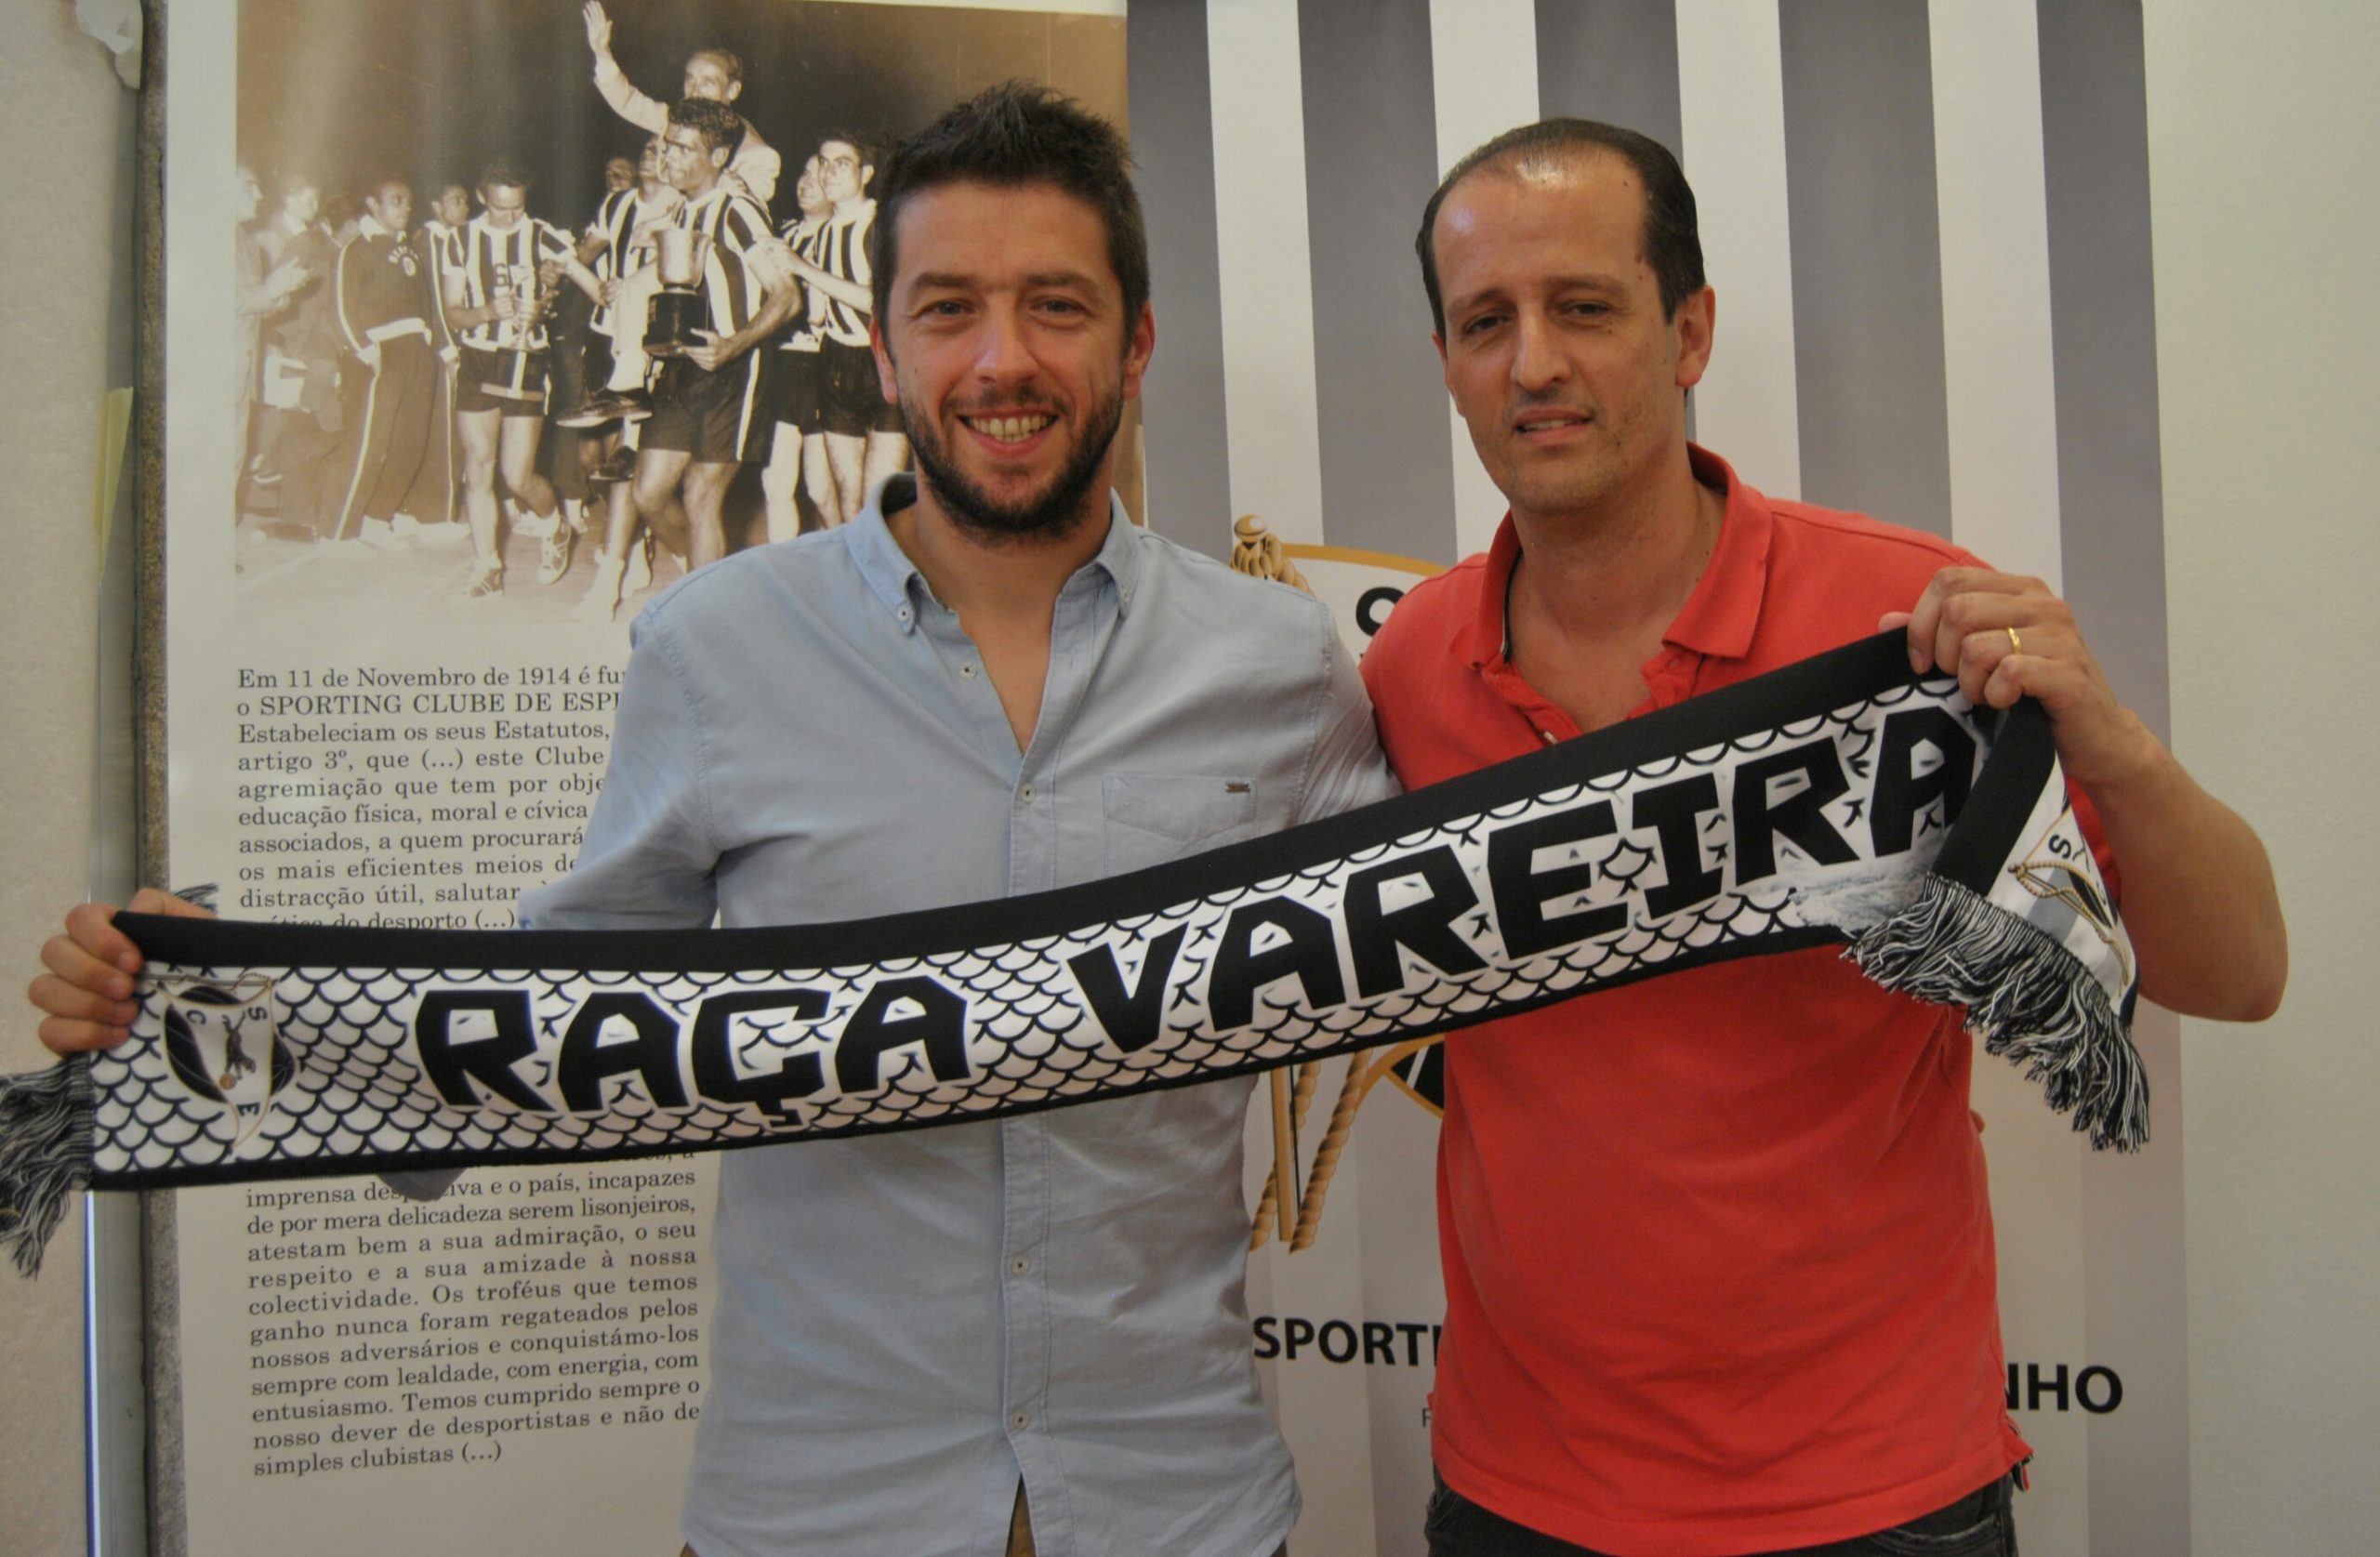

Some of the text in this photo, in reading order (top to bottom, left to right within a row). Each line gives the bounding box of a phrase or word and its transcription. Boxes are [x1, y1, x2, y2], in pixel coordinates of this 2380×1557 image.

[239, 669, 277, 688] Em
[289, 670, 311, 687] 11
[323, 668, 349, 687] de
[358, 667, 475, 686] Novembro
[483, 666, 509, 685] de
[520, 667, 570, 685] 1914
[579, 666, 589, 684] é
[237, 704, 249, 716] o
[261, 694, 401, 715] SPORTING
[414, 693, 504, 713] CLUBE
[516, 693, 551, 712] DE
[239, 720, 608, 743] Estabeleciam os seus Estatutos,
[238, 746, 602, 773] artigo 3º, que (...) este Clube
[239, 778, 382, 802] agremiação
[395, 782, 437, 798] que
[451, 778, 495, 793] tem
[509, 780, 548, 797] por
[239, 800, 587, 828] educação física, moral e cívica
[240, 832, 369, 852] associados,
[379, 837, 391, 849] a
[401, 836, 462, 852] quem
[240, 868, 264, 880] os
[278, 860, 335, 879] mais
[348, 858, 463, 877] eficientes
[476, 855, 543, 874] meios
[240, 883, 520, 909] distracção útil, salutar
[369, 912, 467, 930] desporto
[415, 706, 1977, 1127] RAÇA VAREIRA
[247, 1190, 354, 1209] imprensa
[491, 1182, 502, 1194] e
[509, 1181, 521, 1193] o
[529, 1173, 579, 1196] país,
[589, 1172, 694, 1197] incapazes
[247, 1195, 694, 1236] de por mera delicadeza serem lisonjeiros,
[248, 1225, 695, 1261] atestam bem a sua admiração, o seu
[249, 1249, 695, 1290] respeito e a sua amizade à nossa
[249, 1277, 696, 1315] colectividade. Os troféus que temos
[251, 1299, 697, 1346] ganho nunca foram regateados pelos
[252, 1325, 698, 1368] nossos adversários e conquistámo-los
[253, 1353, 697, 1402] sempre com lealdade, com energia, com
[253, 1381, 699, 1421] entusiasmo. Temos cumprido sempre o
[254, 1402, 699, 1449] nosso dever de desportistas e não de
[255, 1441, 501, 1476] simples clubistas (...)
